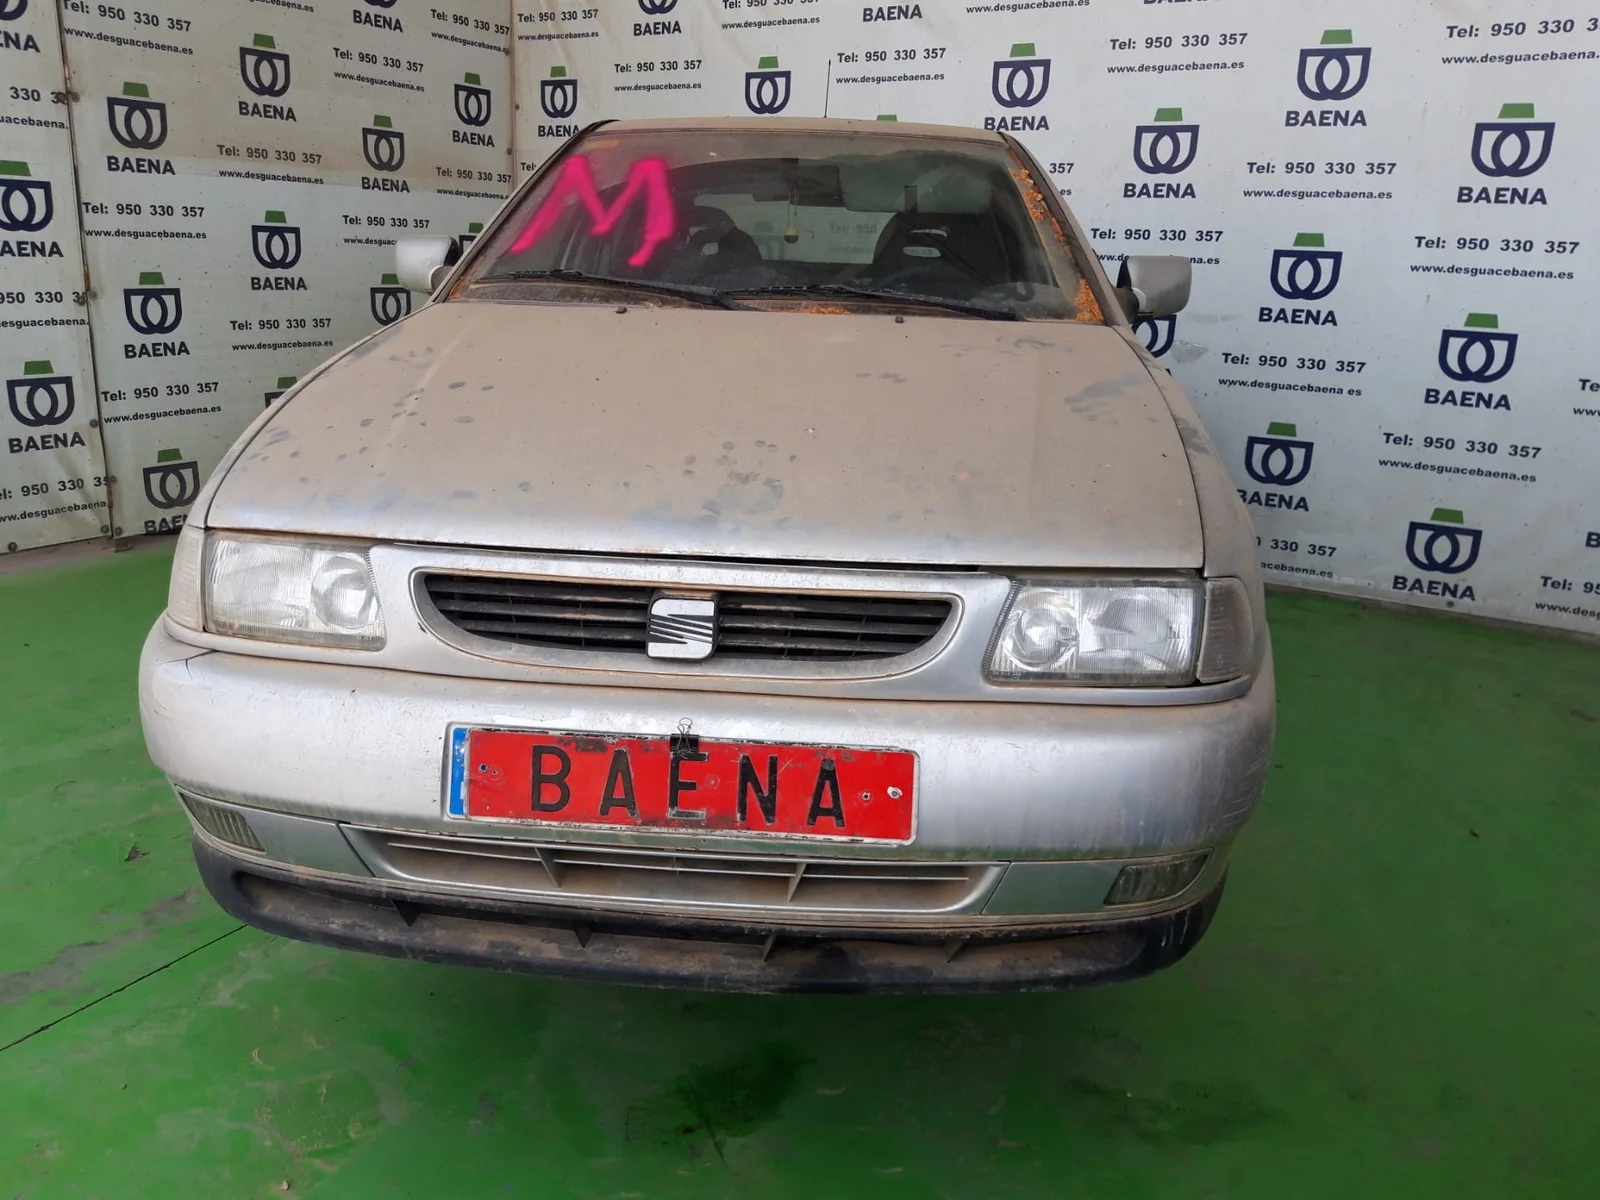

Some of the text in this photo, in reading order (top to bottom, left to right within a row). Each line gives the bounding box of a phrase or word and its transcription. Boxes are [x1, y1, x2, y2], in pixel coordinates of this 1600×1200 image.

[722, 0, 741, 9] Tel:
[863, 4, 922, 22] BAENA
[966, 0, 1090, 13] www.desguacebaena.es
[63, 0, 191, 32] Tel: 950 330 357
[353, 10, 403, 32] BAENA
[431, 9, 510, 36] Tel: 950 330 357
[518, 9, 598, 22] Tel: 950 330 357
[722, 17, 820, 29] www.desguacebaena.es
[518, 32, 599, 41] www.desguacebaena.es
[634, 21, 682, 36] BAENA
[1446, 25, 1479, 38] Tel:
[1491, 22, 1526, 36] 950
[1538, 20, 1574, 34] 330
[64, 27, 193, 56] www.desguacebaena.es
[1110, 33, 1248, 50] Tel: 950 330 357
[334, 48, 424, 72] Tel: 950 330 357
[837, 48, 946, 63] Tel: 950 330 357
[614, 60, 702, 73] Tel: 950 330 357
[1108, 62, 1244, 74] www.desguacebaena.es
[334, 71, 424, 92] www.desguacebaena.es
[614, 82, 702, 92] www.desguacebaena.es
[836, 74, 944, 84] www.desguacebaena.es
[10, 86, 41, 102] 330
[239, 101, 296, 122] BAENA
[1285, 110, 1367, 127] BAENA
[984, 116, 1049, 131] BAENA
[452, 130, 495, 147] BAENA
[217, 145, 322, 164] Tel: 950 330 357
[107, 156, 176, 175] BAENA
[1049, 163, 1074, 174] 357
[1247, 162, 1397, 174] Tel: 950 330 357
[219, 170, 324, 184] www.desguacebaena.es
[436, 167, 512, 184] Tel: 950 330 357
[362, 177, 410, 193] BAENA
[1123, 183, 1196, 198] BAENA
[1244, 189, 1392, 200] www.desguacebaena.es
[1457, 186, 1547, 205] BAENA
[84, 202, 204, 217] Tel: 950 330 357
[342, 215, 430, 228] Tel: 950 330 357
[85, 229, 207, 240] www.desguacebaena.es
[1091, 228, 1223, 242] Tel: 950 330 357
[1415, 236, 1580, 254] Tel: 950 330 357
[1410, 265, 1574, 279] www.desguacebaena.es
[251, 277, 308, 290] BAENA
[35, 292, 63, 303] 330
[230, 318, 331, 330] Tel: 950 330 357
[1259, 307, 1338, 326] BAENA
[124, 342, 190, 359] BAENA
[232, 340, 333, 350] www.desguacebaena.es
[1222, 353, 1366, 373] Tel: 950 330 357
[101, 382, 219, 402] Tel: 950 330 357
[1424, 388, 1511, 411] BAENA
[104, 406, 222, 424] www.desguacebaena.es
[8, 432, 86, 454] BAENA
[1383, 432, 1542, 458] Tel: 950 330 357
[1378, 459, 1537, 482] www.desguacebaena.es
[21, 483, 49, 496] 950
[58, 478, 84, 491] 330
[1270, 539, 1298, 552] 330
[1308, 544, 1336, 557] 357
[1392, 576, 1476, 601] BAENA
[1541, 576, 1572, 591] Tel:
[530, 744, 845, 828] BAENA
